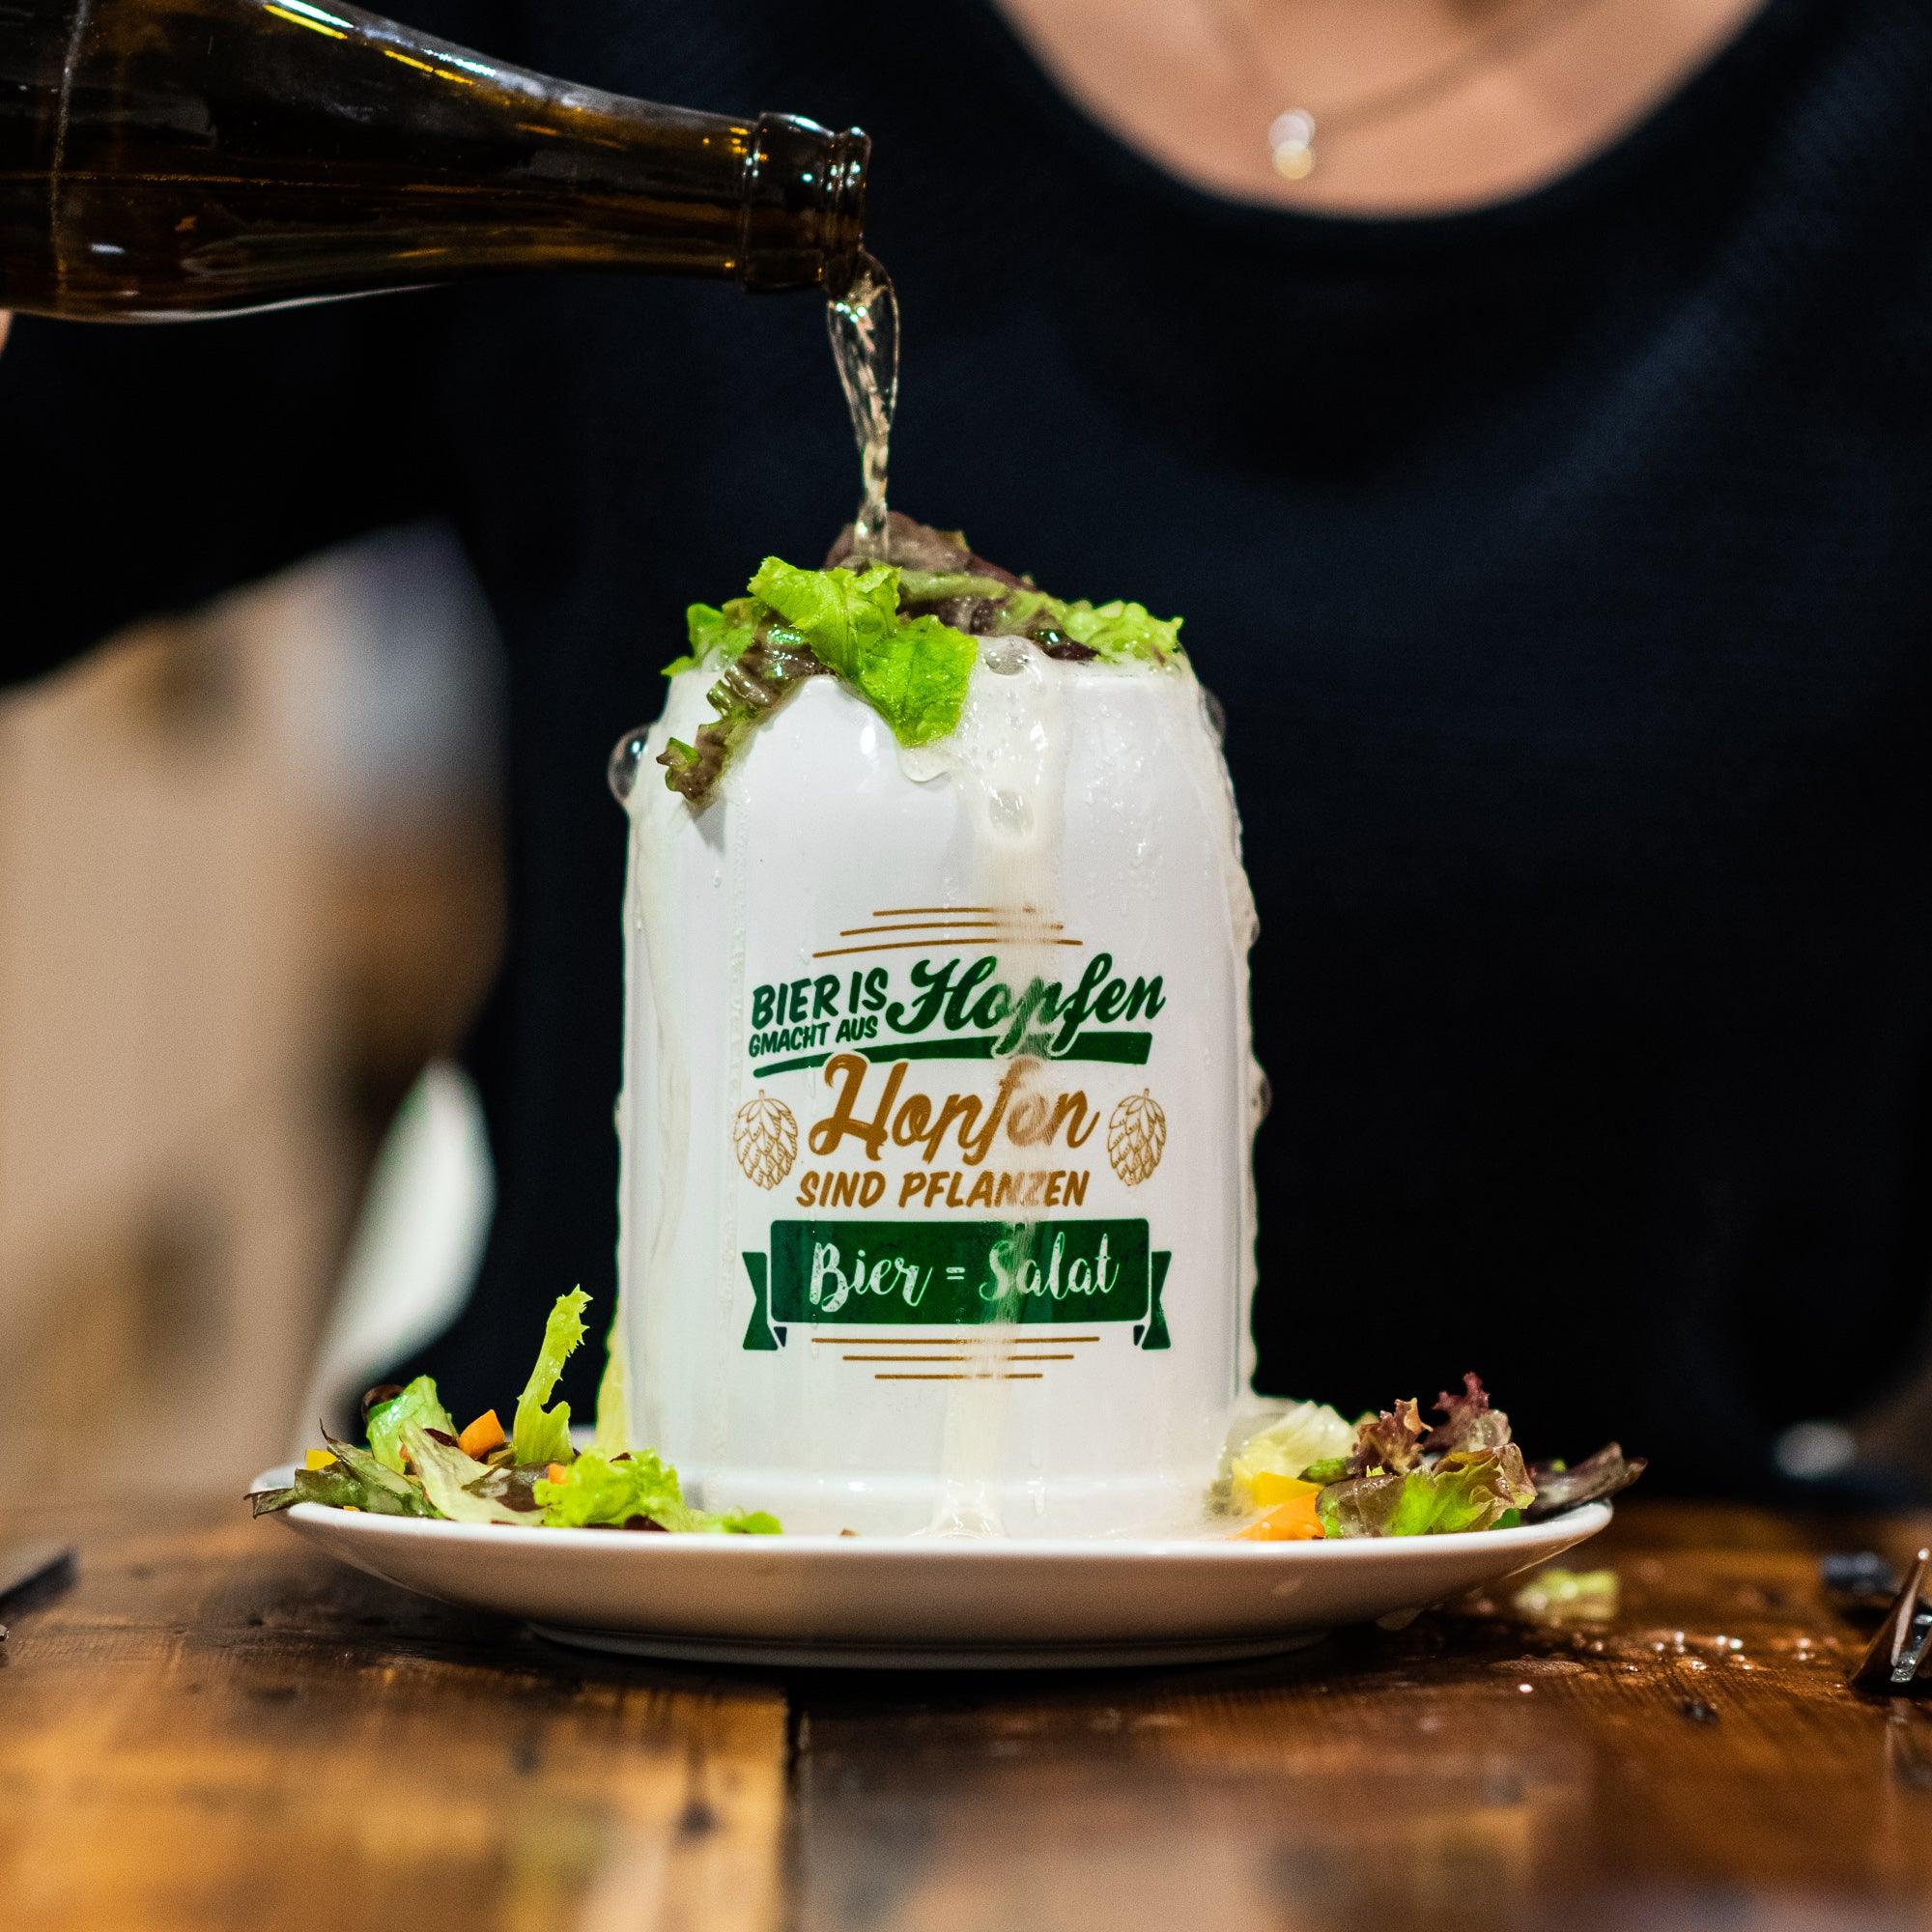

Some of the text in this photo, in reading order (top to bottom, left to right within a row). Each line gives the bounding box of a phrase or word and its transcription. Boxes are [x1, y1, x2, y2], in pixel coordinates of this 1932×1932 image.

[752, 952, 1166, 1057] BIER IS Hopfen
[749, 1015, 878, 1058] GMACHT AUS
[796, 1170, 1090, 1208] SIND PFLANZEN
[810, 1241, 933, 1313] Bier
[980, 1232, 1120, 1300] Salat
